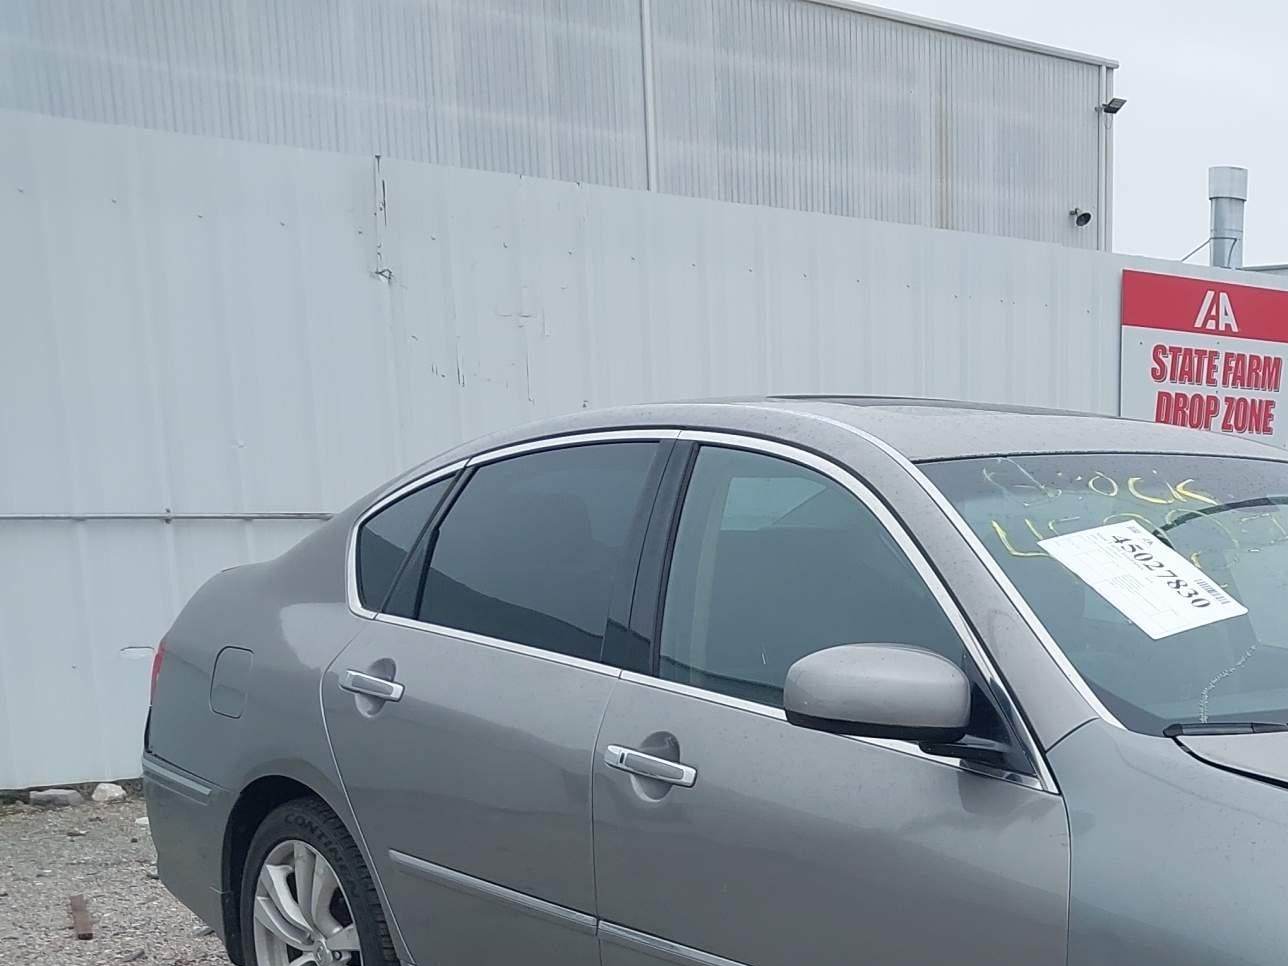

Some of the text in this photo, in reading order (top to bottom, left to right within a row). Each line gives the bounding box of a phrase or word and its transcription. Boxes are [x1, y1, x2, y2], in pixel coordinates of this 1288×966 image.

[1151, 344, 1283, 392] STATE FARM
[1155, 390, 1275, 435] DROP ZONE
[1111, 535, 1211, 608] 45027830
